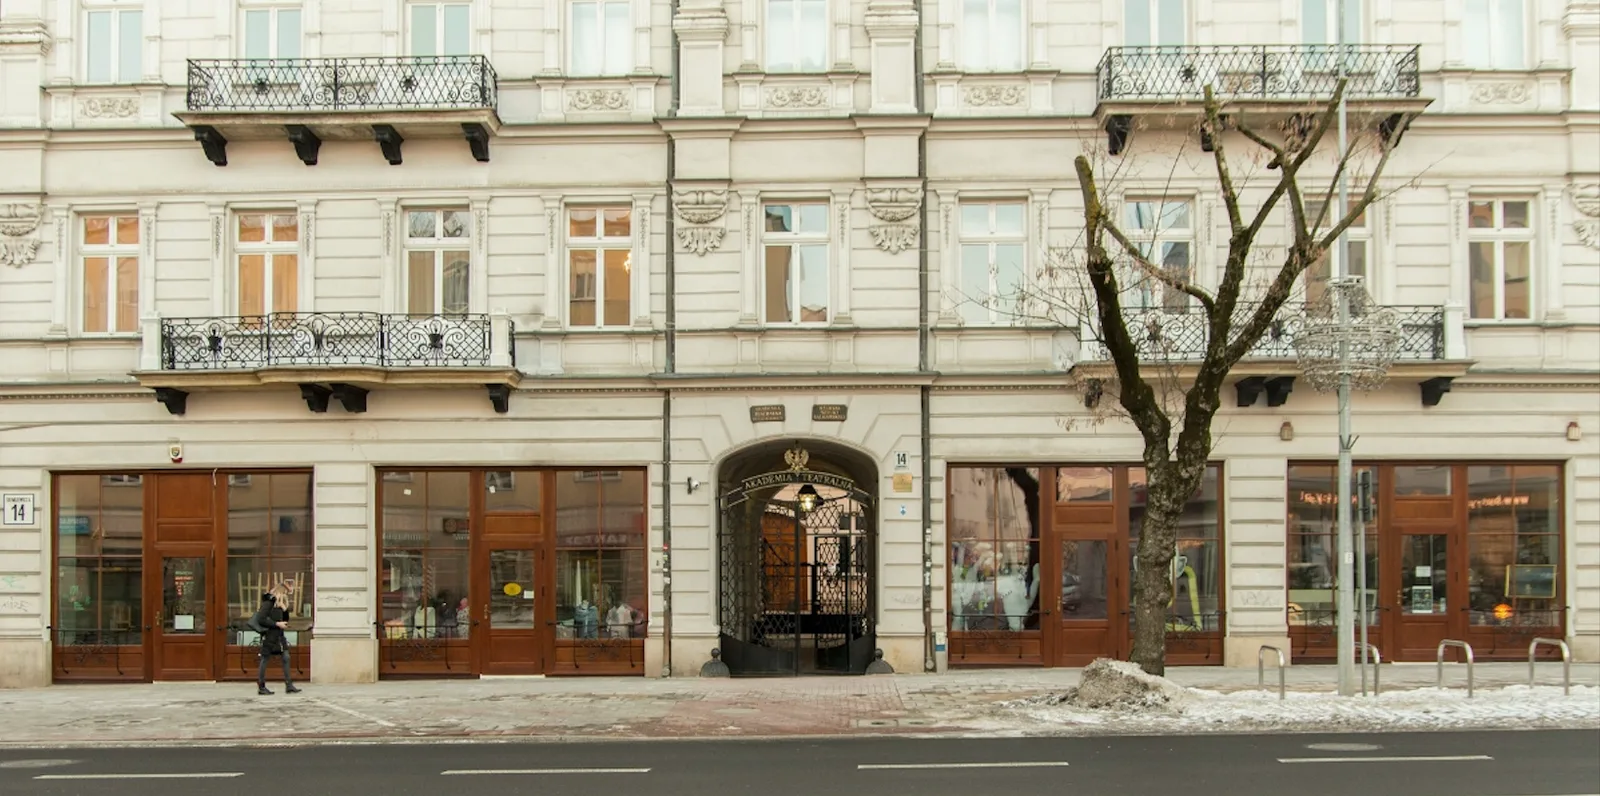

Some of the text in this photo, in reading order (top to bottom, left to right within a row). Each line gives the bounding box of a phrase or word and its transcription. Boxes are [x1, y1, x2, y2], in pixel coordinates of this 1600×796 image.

[896, 453, 906, 465] 14
[744, 473, 853, 491] AKADEMIA TEATRALNA
[11, 504, 25, 521] 14
